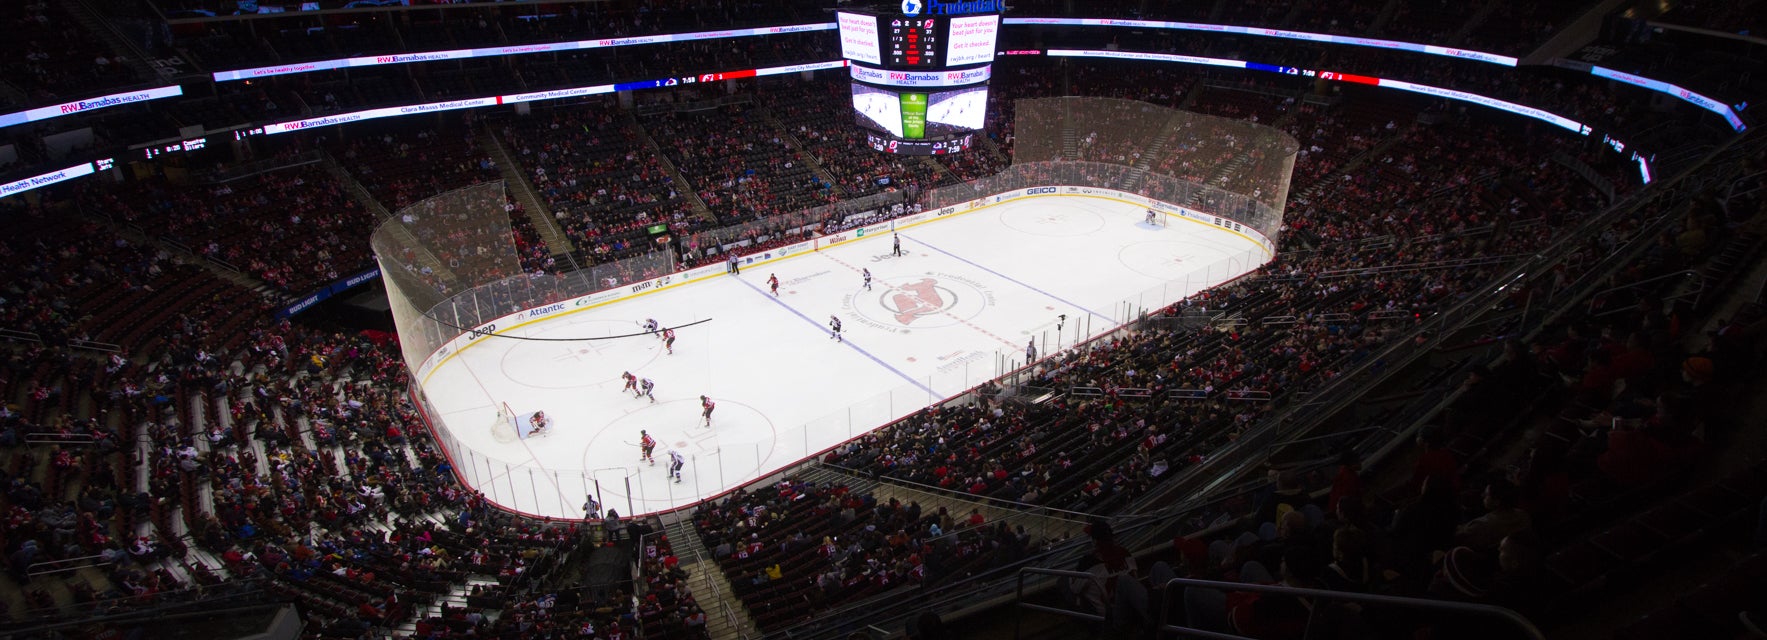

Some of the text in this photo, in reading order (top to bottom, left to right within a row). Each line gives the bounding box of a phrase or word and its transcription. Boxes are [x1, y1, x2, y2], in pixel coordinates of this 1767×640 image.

[600, 38, 637, 47] RWJBarnabas
[376, 54, 427, 64] RWJBarnabas
[890, 72, 940, 81] RWJBarnabas
[947, 70, 984, 80] RWJBarnabas
[516, 88, 588, 101] Community Medical Center
[61, 93, 151, 114] RWJBarnabas HEALTH
[400, 105, 418, 113] Clara
[440, 101, 464, 109] Medical
[464, 98, 485, 107] Center
[284, 114, 361, 131] RWJBarnabas HEALTH
[2, 171, 67, 193] Health Network
[1027, 187, 1056, 195] GEICO
[938, 207, 955, 216] Jeep
[346, 270, 379, 287] BUD LIGHT
[289, 295, 319, 314] BUD LIGHT
[530, 303, 565, 317] Atlantic
[469, 324, 497, 340] Jeep
